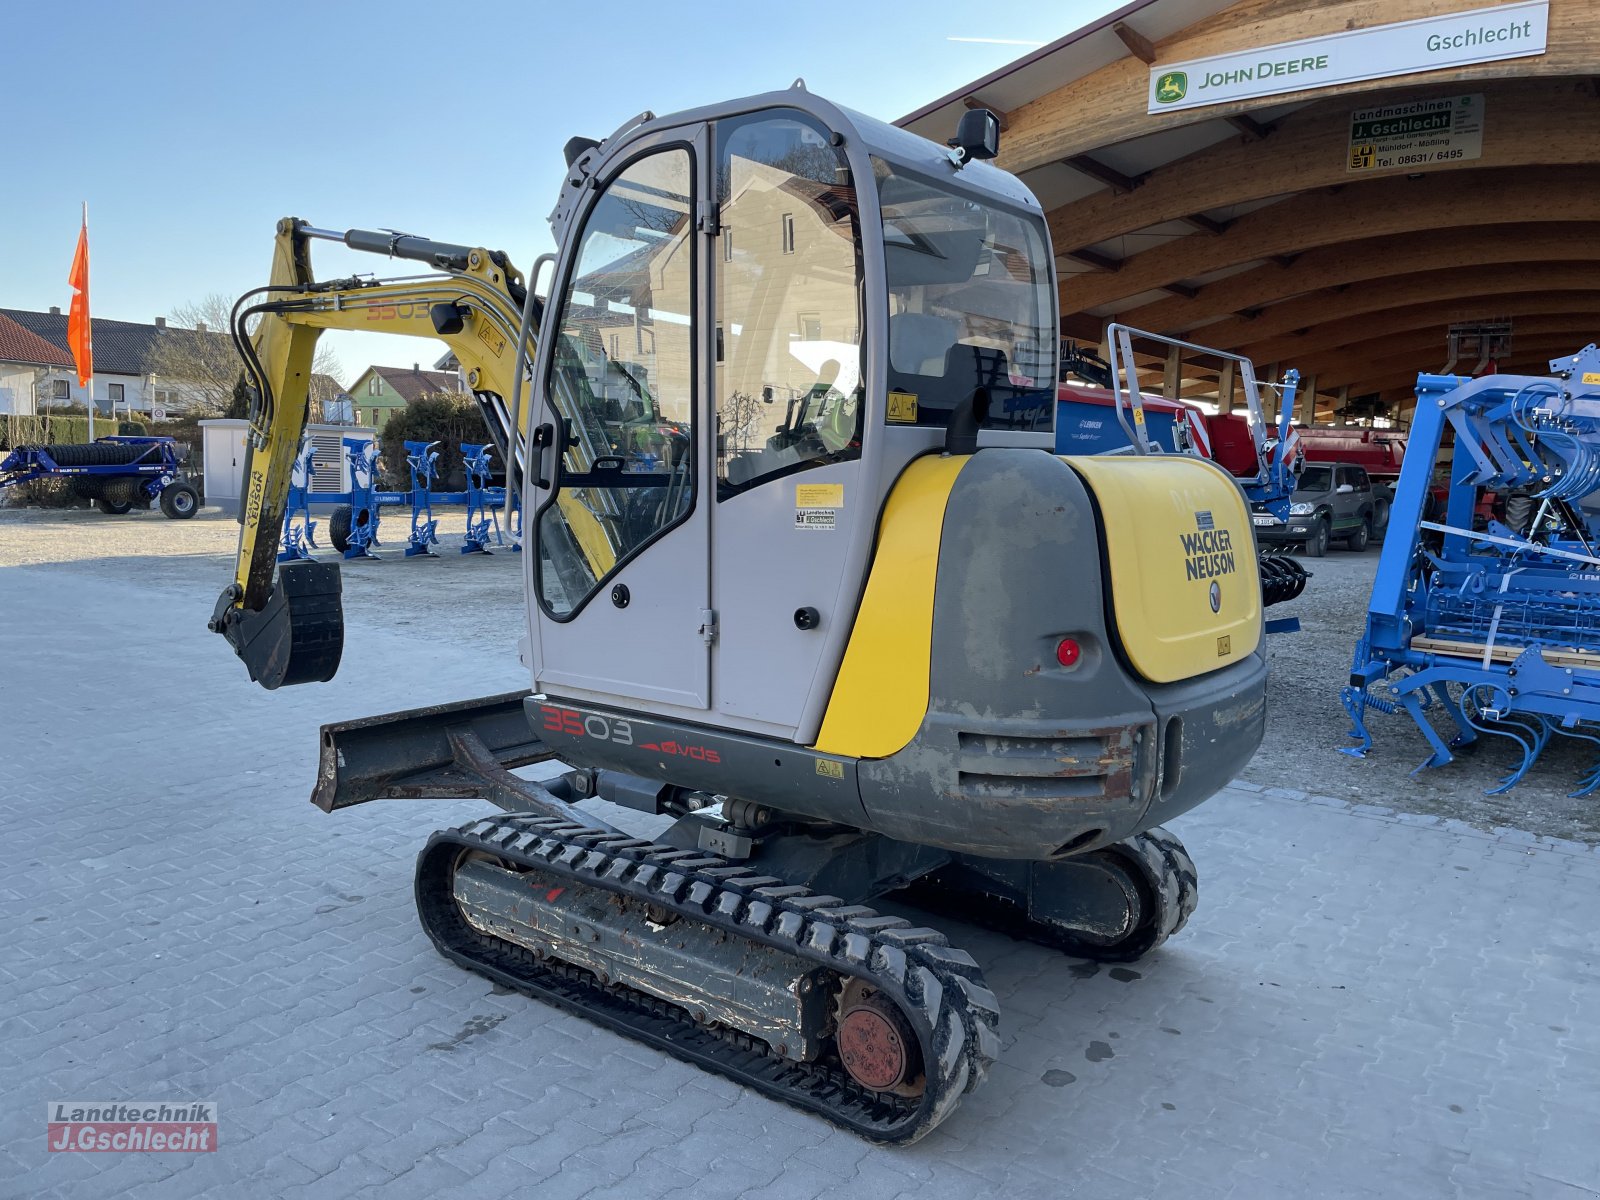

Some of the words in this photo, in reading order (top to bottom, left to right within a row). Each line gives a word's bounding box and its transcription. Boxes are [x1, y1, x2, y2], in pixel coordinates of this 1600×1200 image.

[1426, 20, 1531, 52] Gschlecht
[1198, 67, 1253, 90] JOHN
[1257, 54, 1329, 80] DEERE
[1353, 100, 1453, 121] Landmaschinen
[1355, 126, 1367, 138] J.
[1371, 114, 1448, 136] Gschlecht
[1377, 157, 1395, 168] Tel.
[1437, 149, 1463, 160] 6495
[1378, 142, 1413, 153] Mühldorf
[1179, 529, 1232, 556] WACKER
[1184, 551, 1235, 581] NEUSON
[540, 706, 634, 746] 3503
